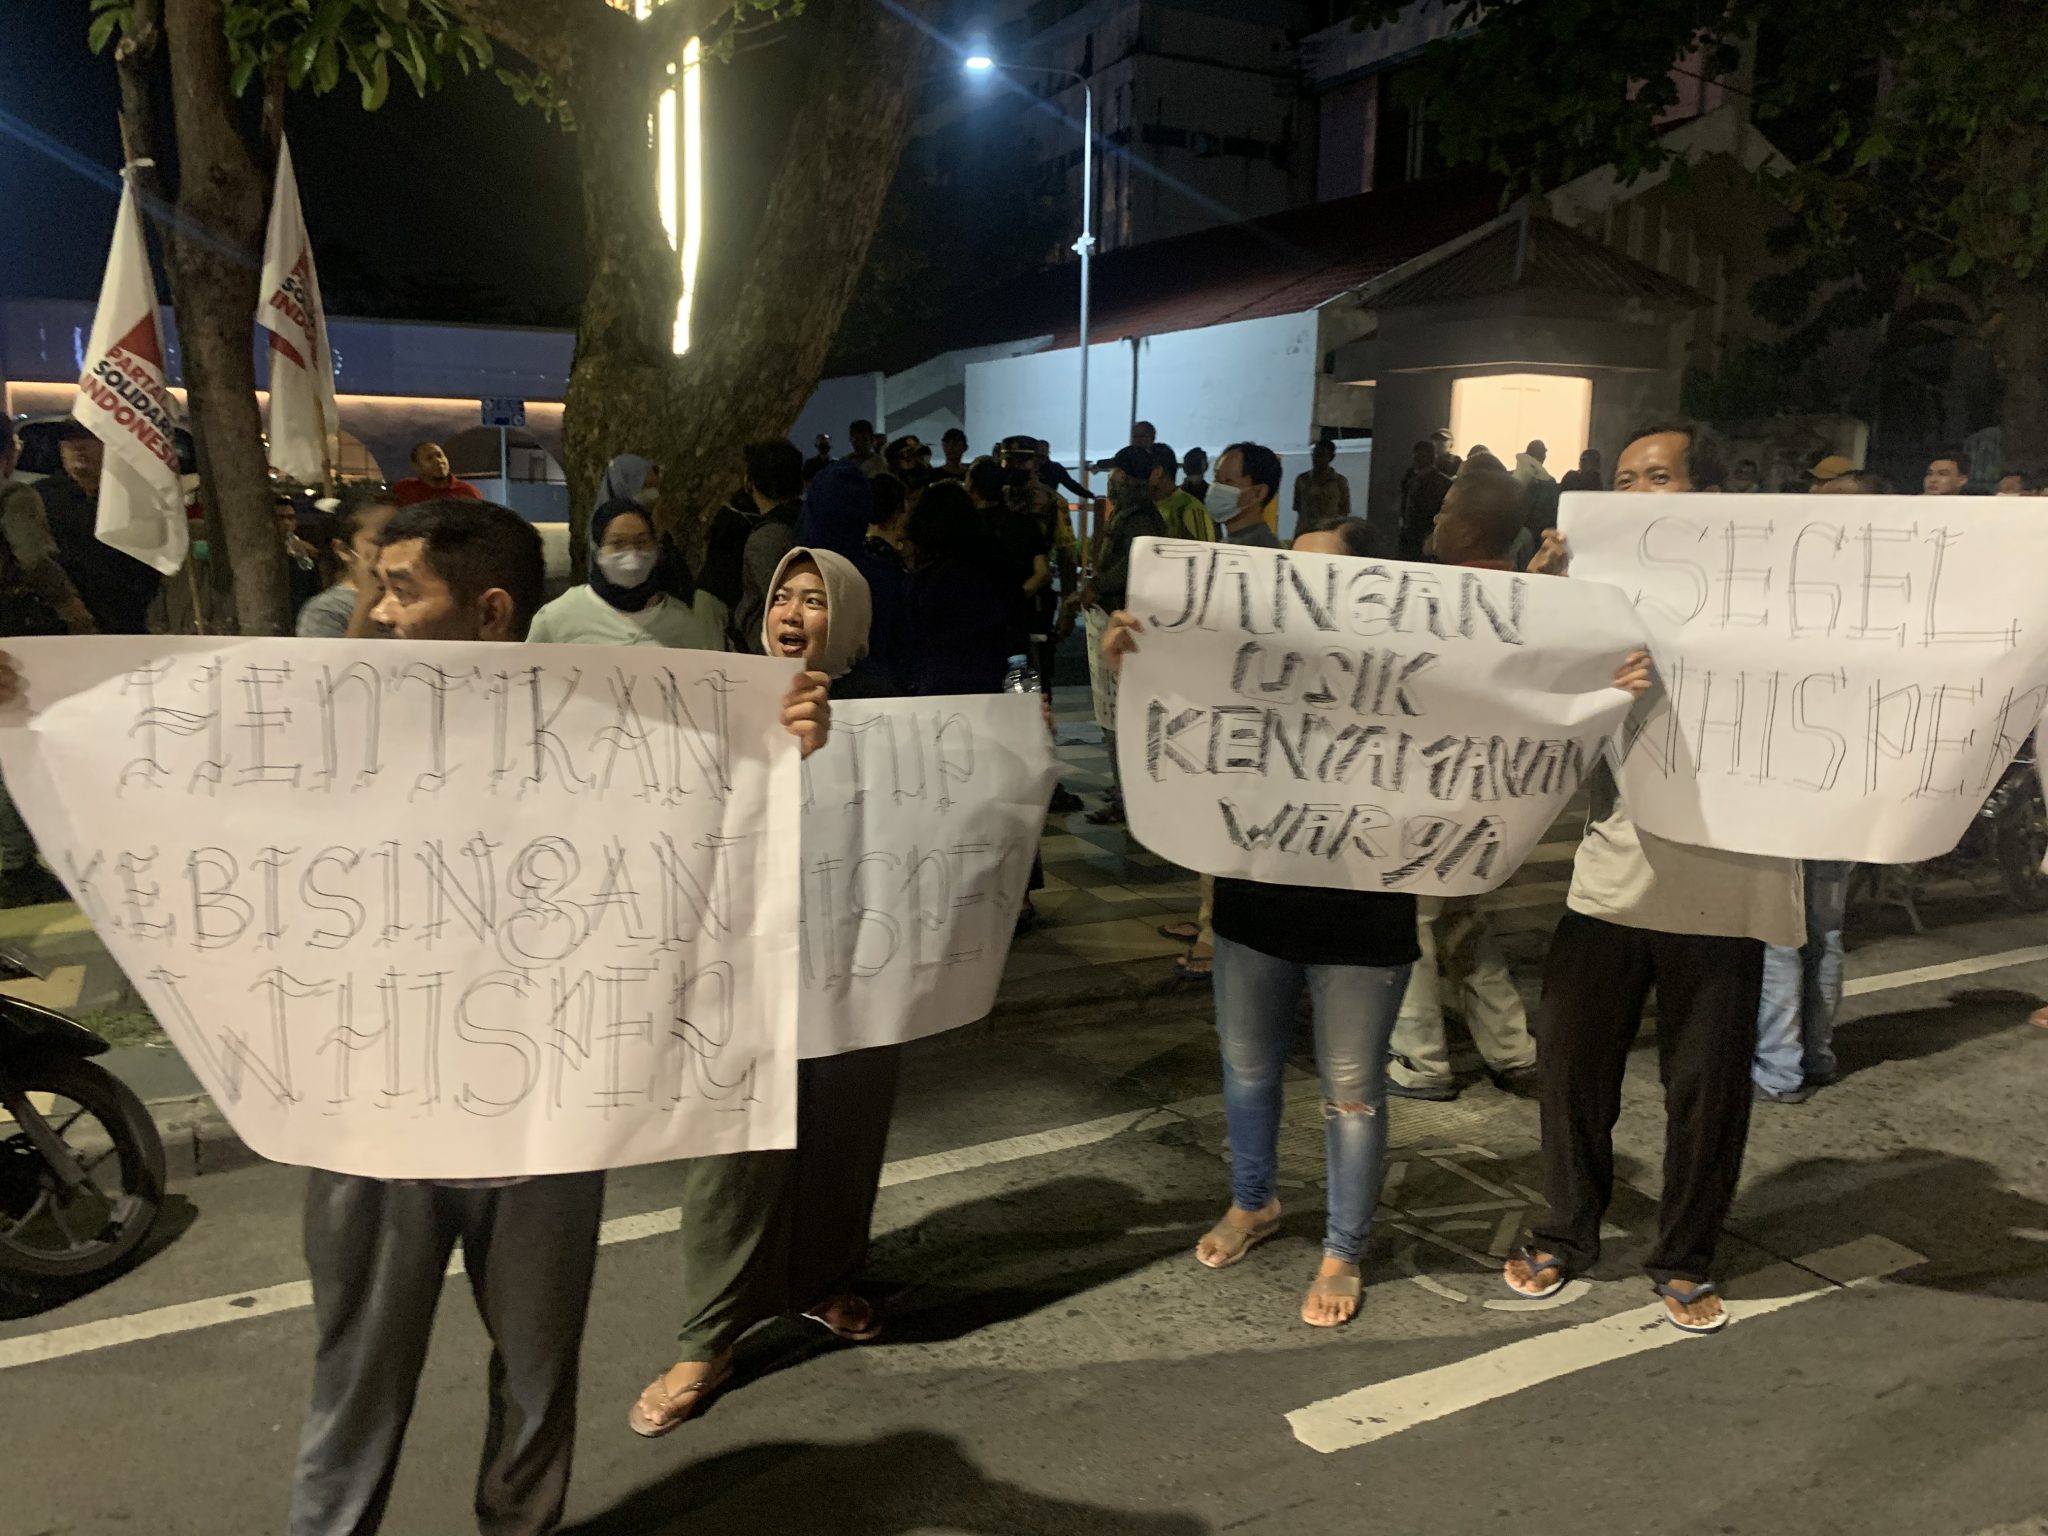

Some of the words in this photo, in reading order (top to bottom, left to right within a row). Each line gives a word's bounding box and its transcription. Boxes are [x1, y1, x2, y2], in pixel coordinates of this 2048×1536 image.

[1149, 542, 1529, 646] JANGAN
[1632, 515, 2021, 649] SEGEL
[117, 655, 748, 806] HENTIKAN
[1231, 640, 1441, 717] USIK
[146, 959, 765, 1121] WHISPER
